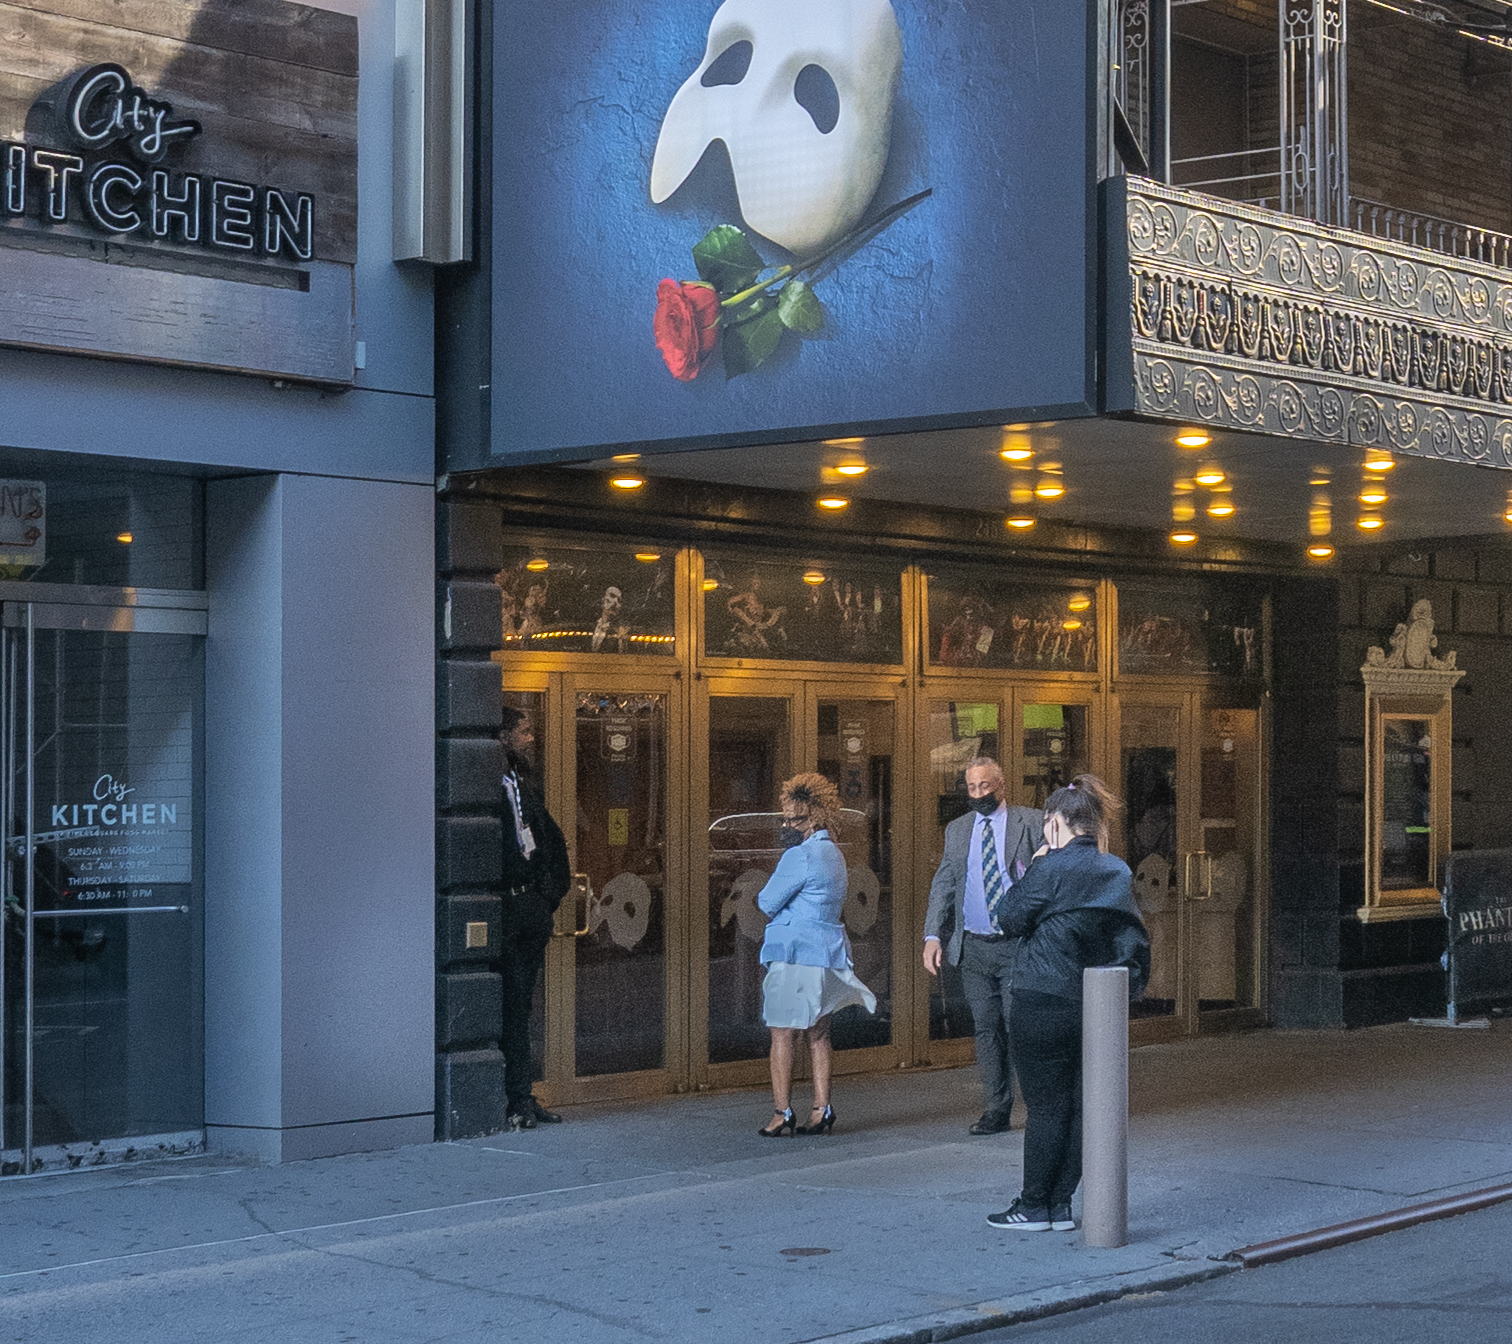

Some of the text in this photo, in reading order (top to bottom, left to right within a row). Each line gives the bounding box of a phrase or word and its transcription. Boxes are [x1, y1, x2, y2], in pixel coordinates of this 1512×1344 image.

[72, 69, 197, 155] City
[6, 145, 313, 260] ITCHEN
[93, 774, 136, 801] City
[51, 803, 177, 826] KITCHEN
[68, 847, 103, 857] SUNDAY
[68, 876, 113, 886] THURSDAY
